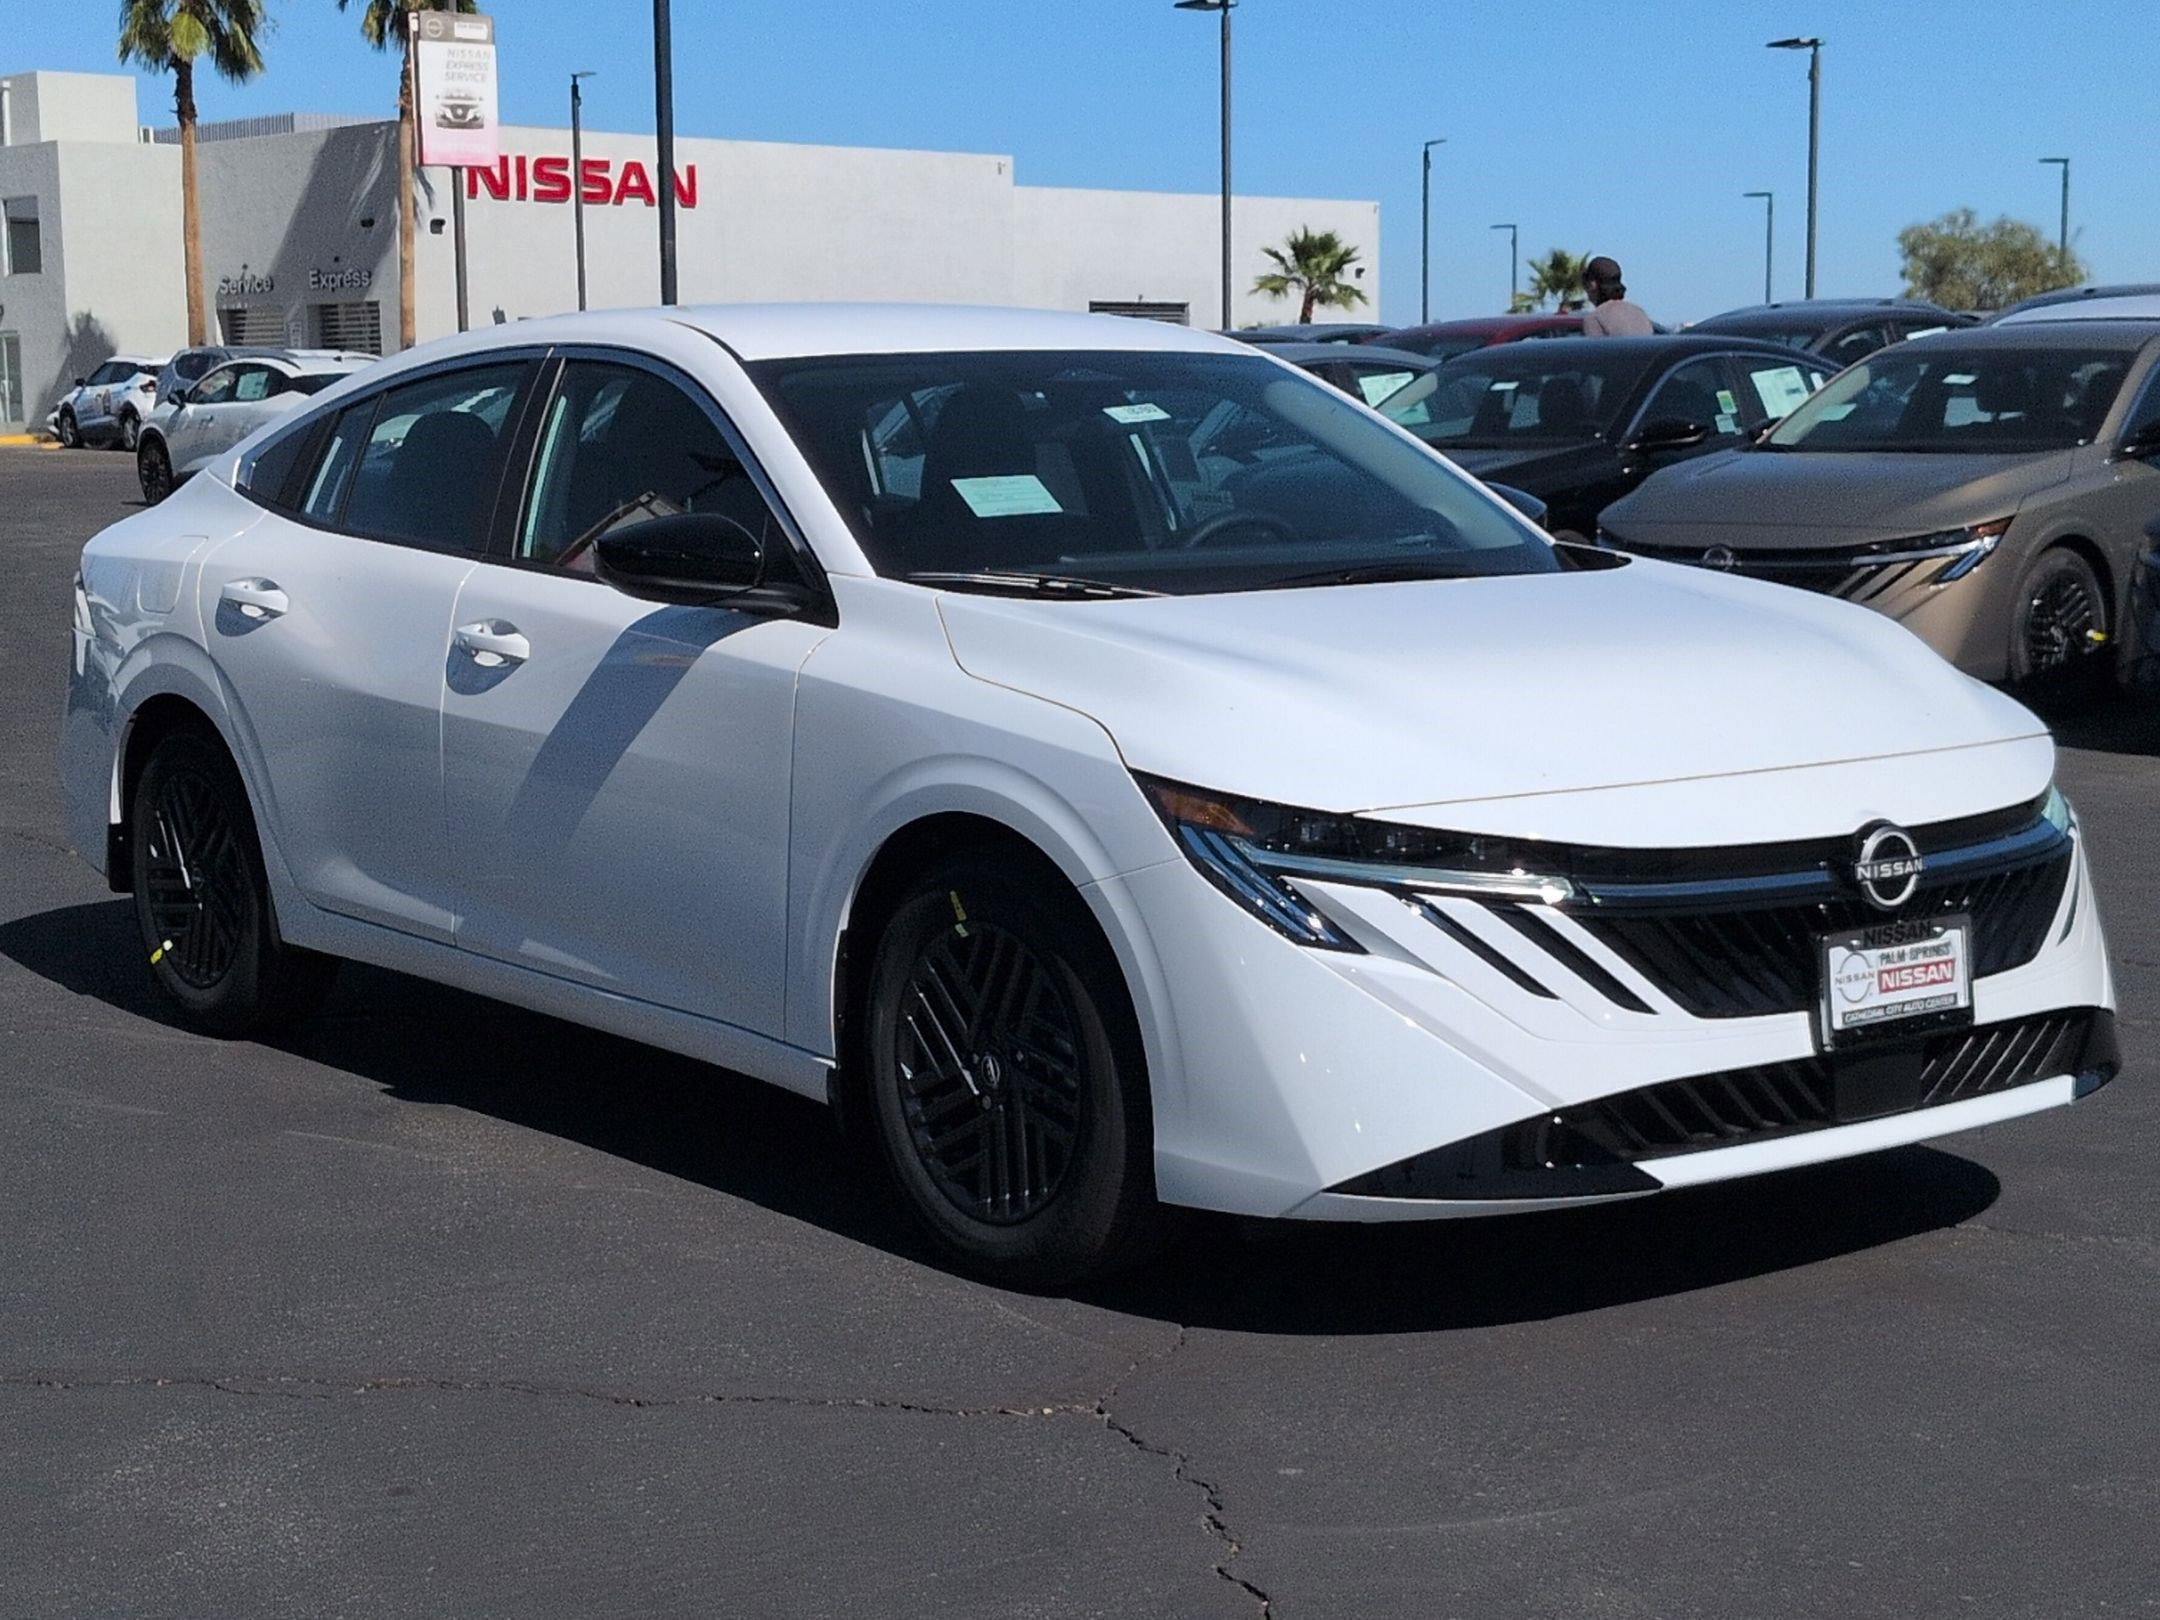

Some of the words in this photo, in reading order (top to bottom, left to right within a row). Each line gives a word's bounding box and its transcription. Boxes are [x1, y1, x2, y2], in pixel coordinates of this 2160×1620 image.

[467, 155, 697, 209] NISSAN
[219, 275, 273, 295] Service
[308, 269, 371, 292] Express
[1856, 859, 1923, 880] NISSAN
[1864, 921, 1931, 945] NISSAN
[1879, 948, 1906, 966] PALM
[1834, 970, 1875, 985] NISSAN
[1881, 962, 1953, 990] NISSAN
